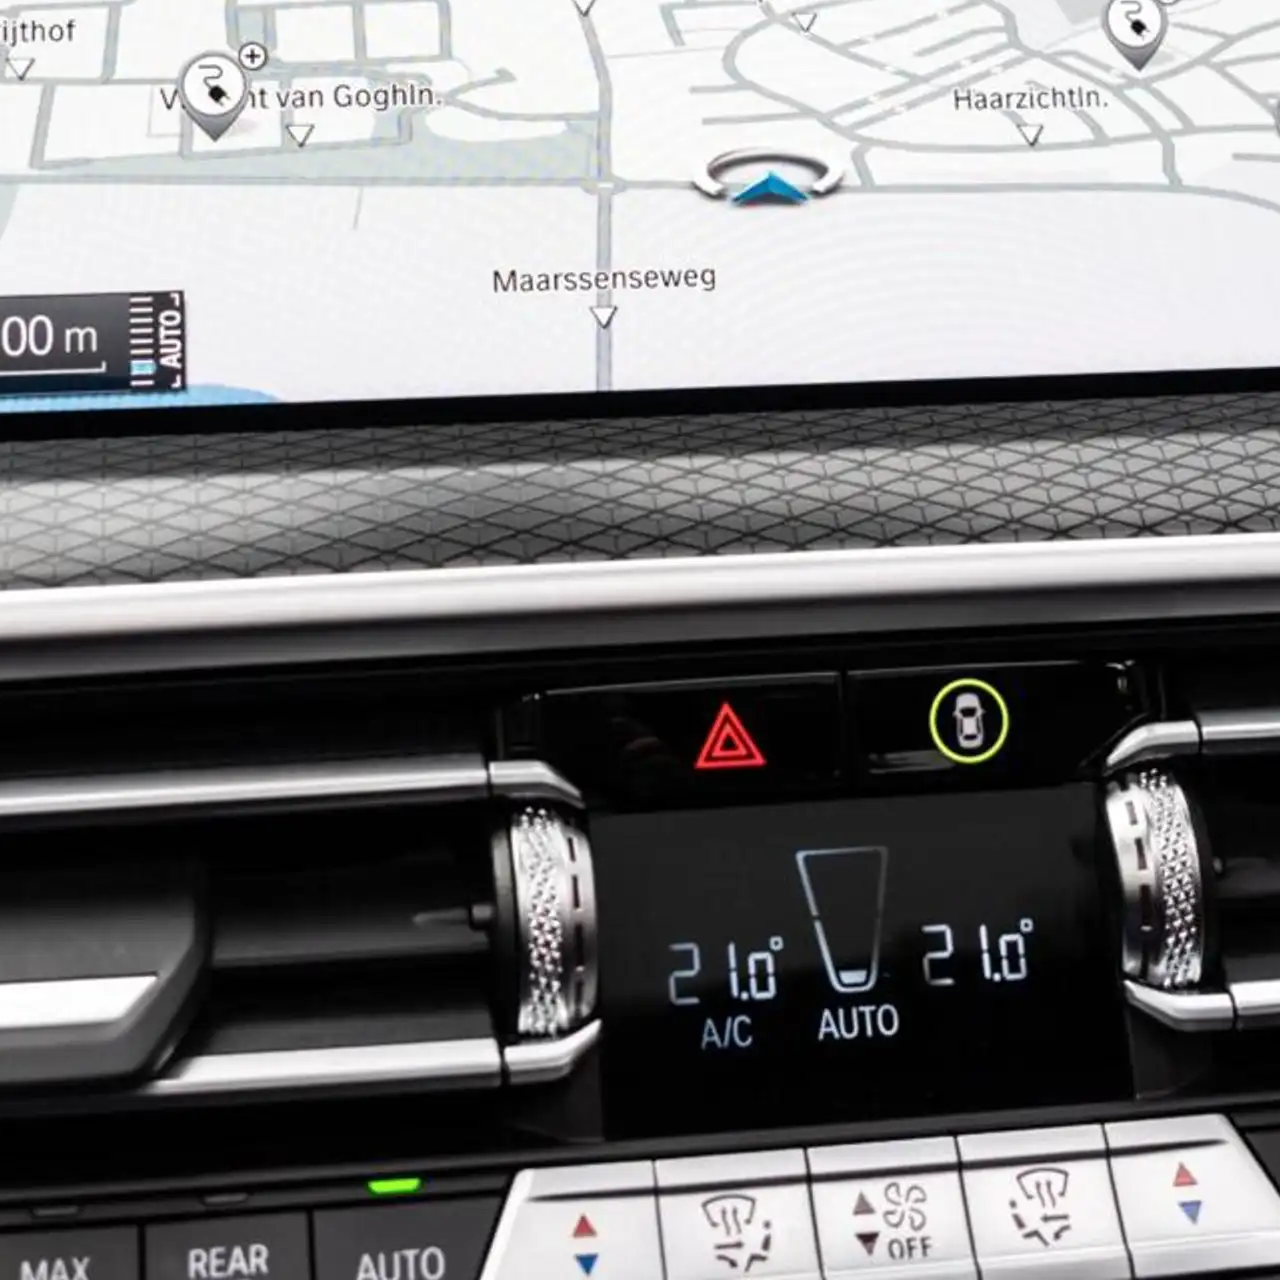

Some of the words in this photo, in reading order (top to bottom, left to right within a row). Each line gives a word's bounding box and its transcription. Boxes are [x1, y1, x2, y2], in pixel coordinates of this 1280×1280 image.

[278, 88, 324, 108] van
[492, 268, 716, 293] Maarssenseweg
[65, 325, 98, 354] m
[159, 309, 182, 370] AUTO
[701, 1016, 754, 1051] A/C
[818, 1004, 900, 1042] AUTO
[187, 1244, 270, 1278] REAR
[356, 1247, 446, 1280] AUTO
[888, 1235, 935, 1261] OFF
[20, 1256, 91, 1280] MAX
